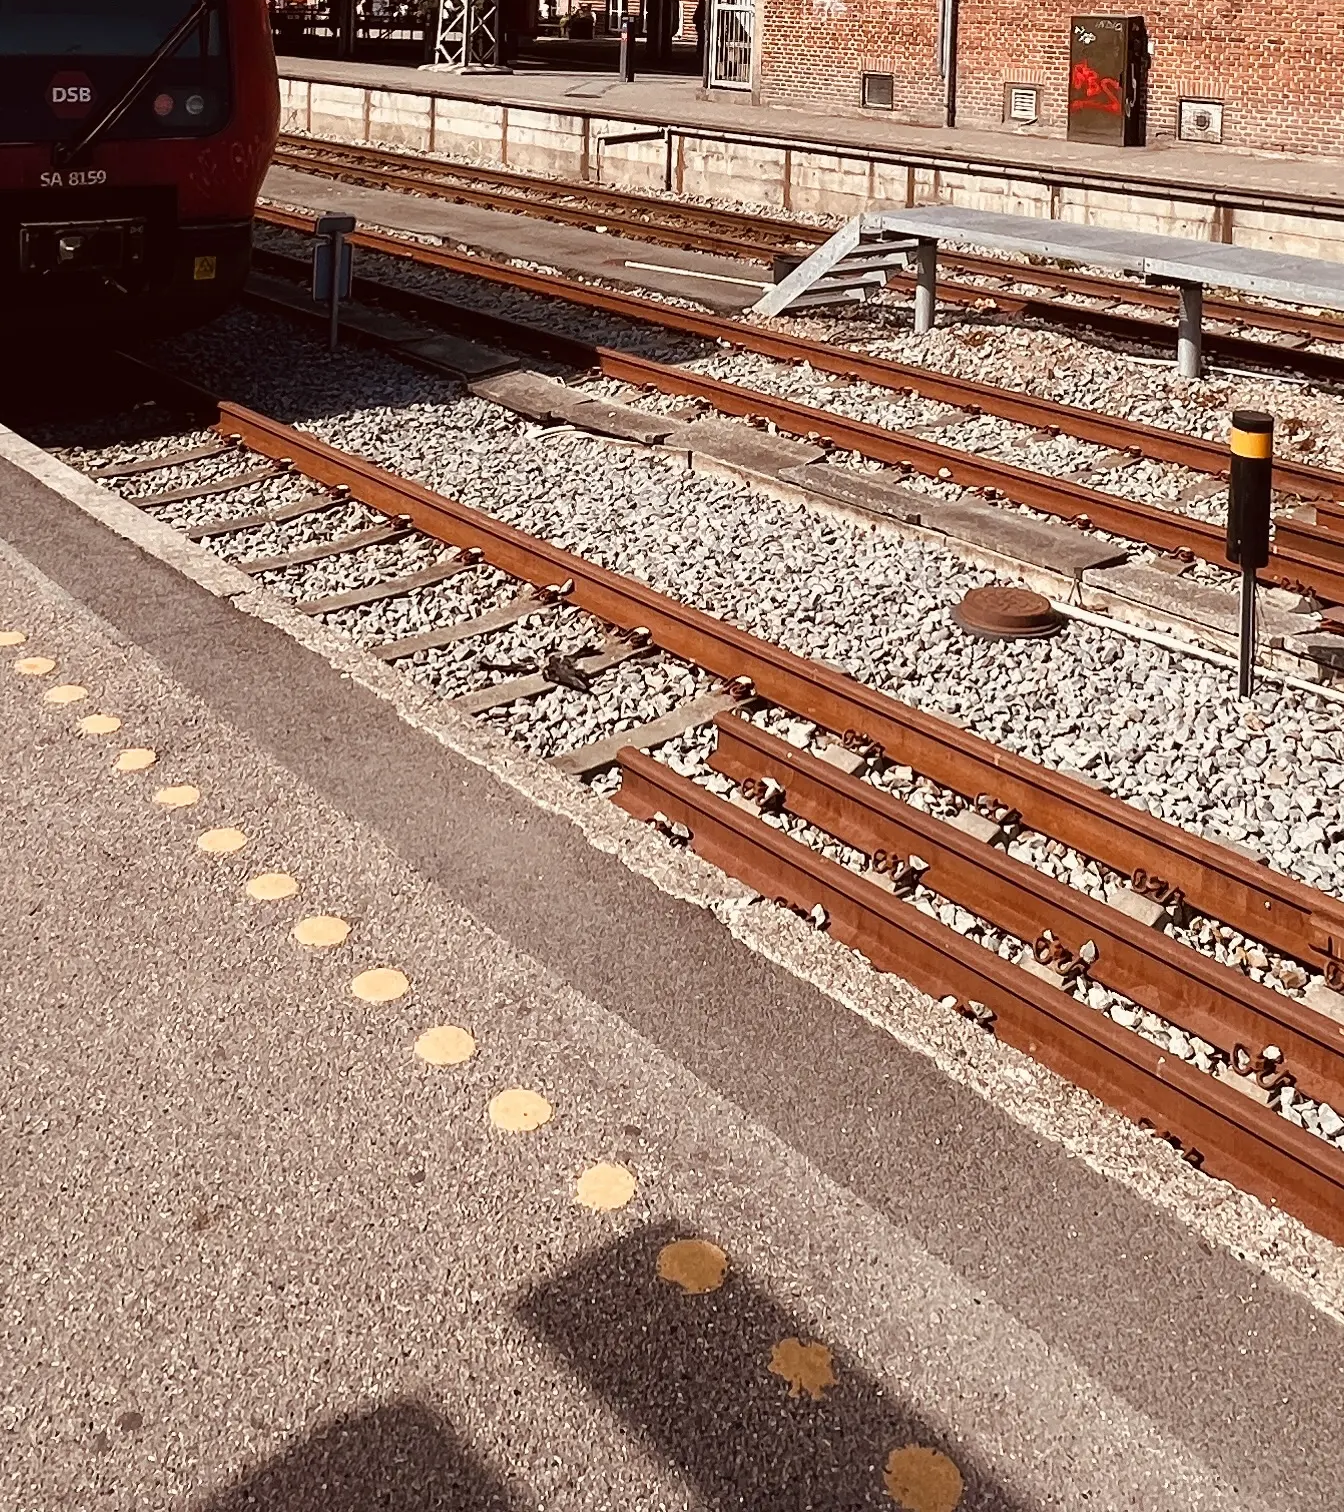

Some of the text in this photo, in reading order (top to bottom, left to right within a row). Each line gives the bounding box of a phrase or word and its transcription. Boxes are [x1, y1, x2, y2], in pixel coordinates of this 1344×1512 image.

[52, 87, 91, 102] DSB
[40, 170, 107, 186] SA 8159
